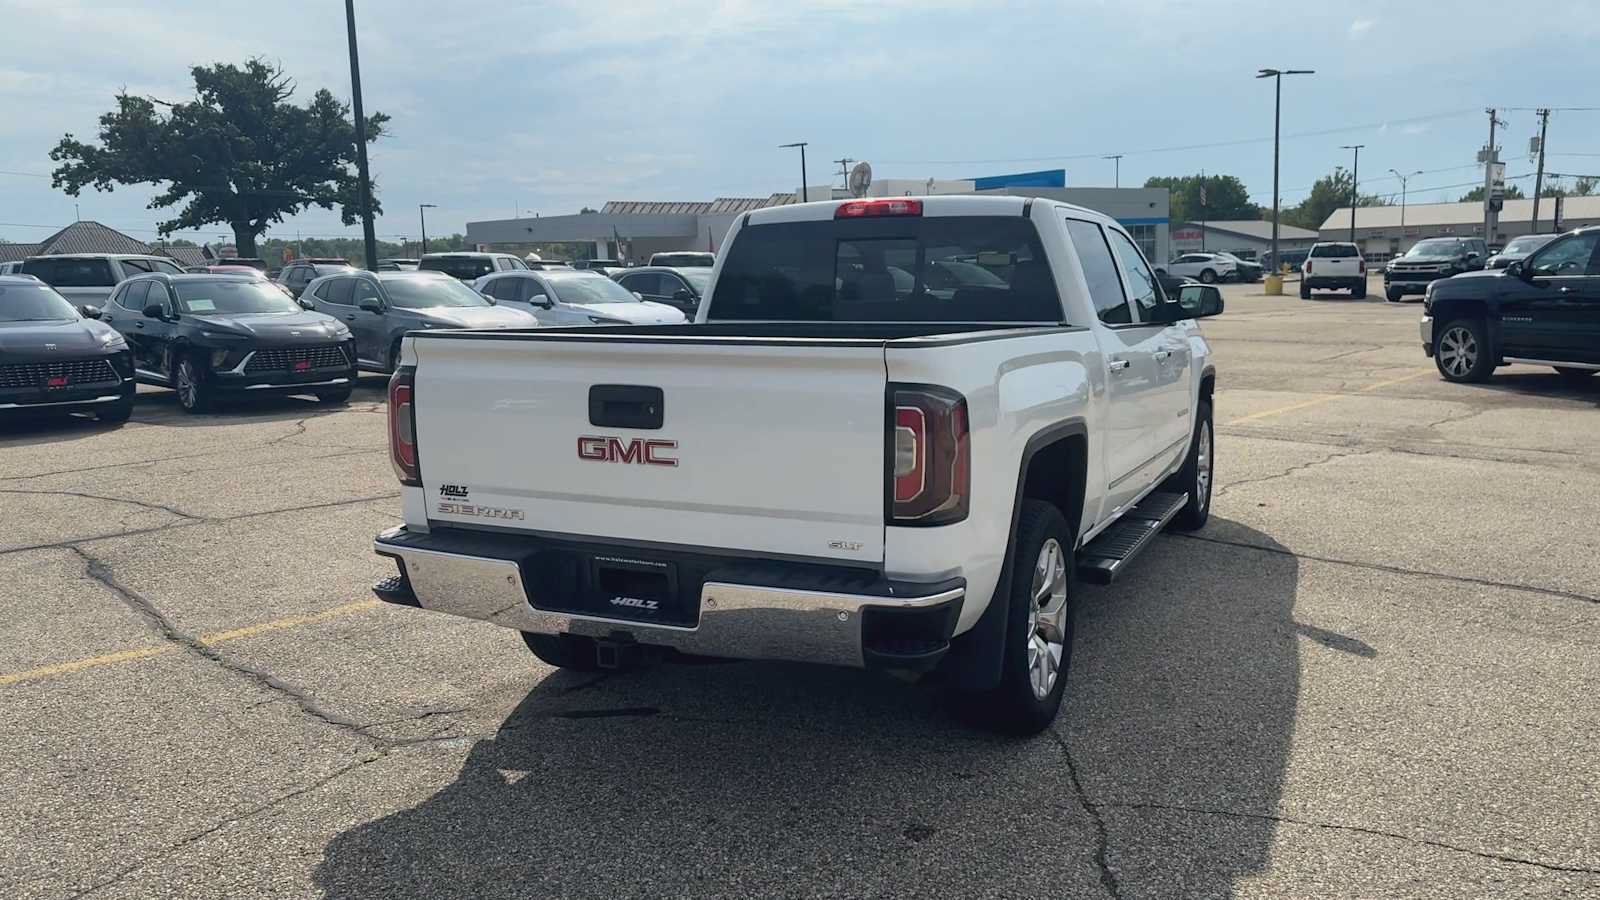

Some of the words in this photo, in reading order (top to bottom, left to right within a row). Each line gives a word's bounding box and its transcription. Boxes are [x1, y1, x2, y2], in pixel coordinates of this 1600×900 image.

[577, 436, 679, 467] GMC
[440, 484, 469, 497] HOLZ
[438, 503, 525, 520] SIERRA
[610, 597, 659, 610] HOLZ
